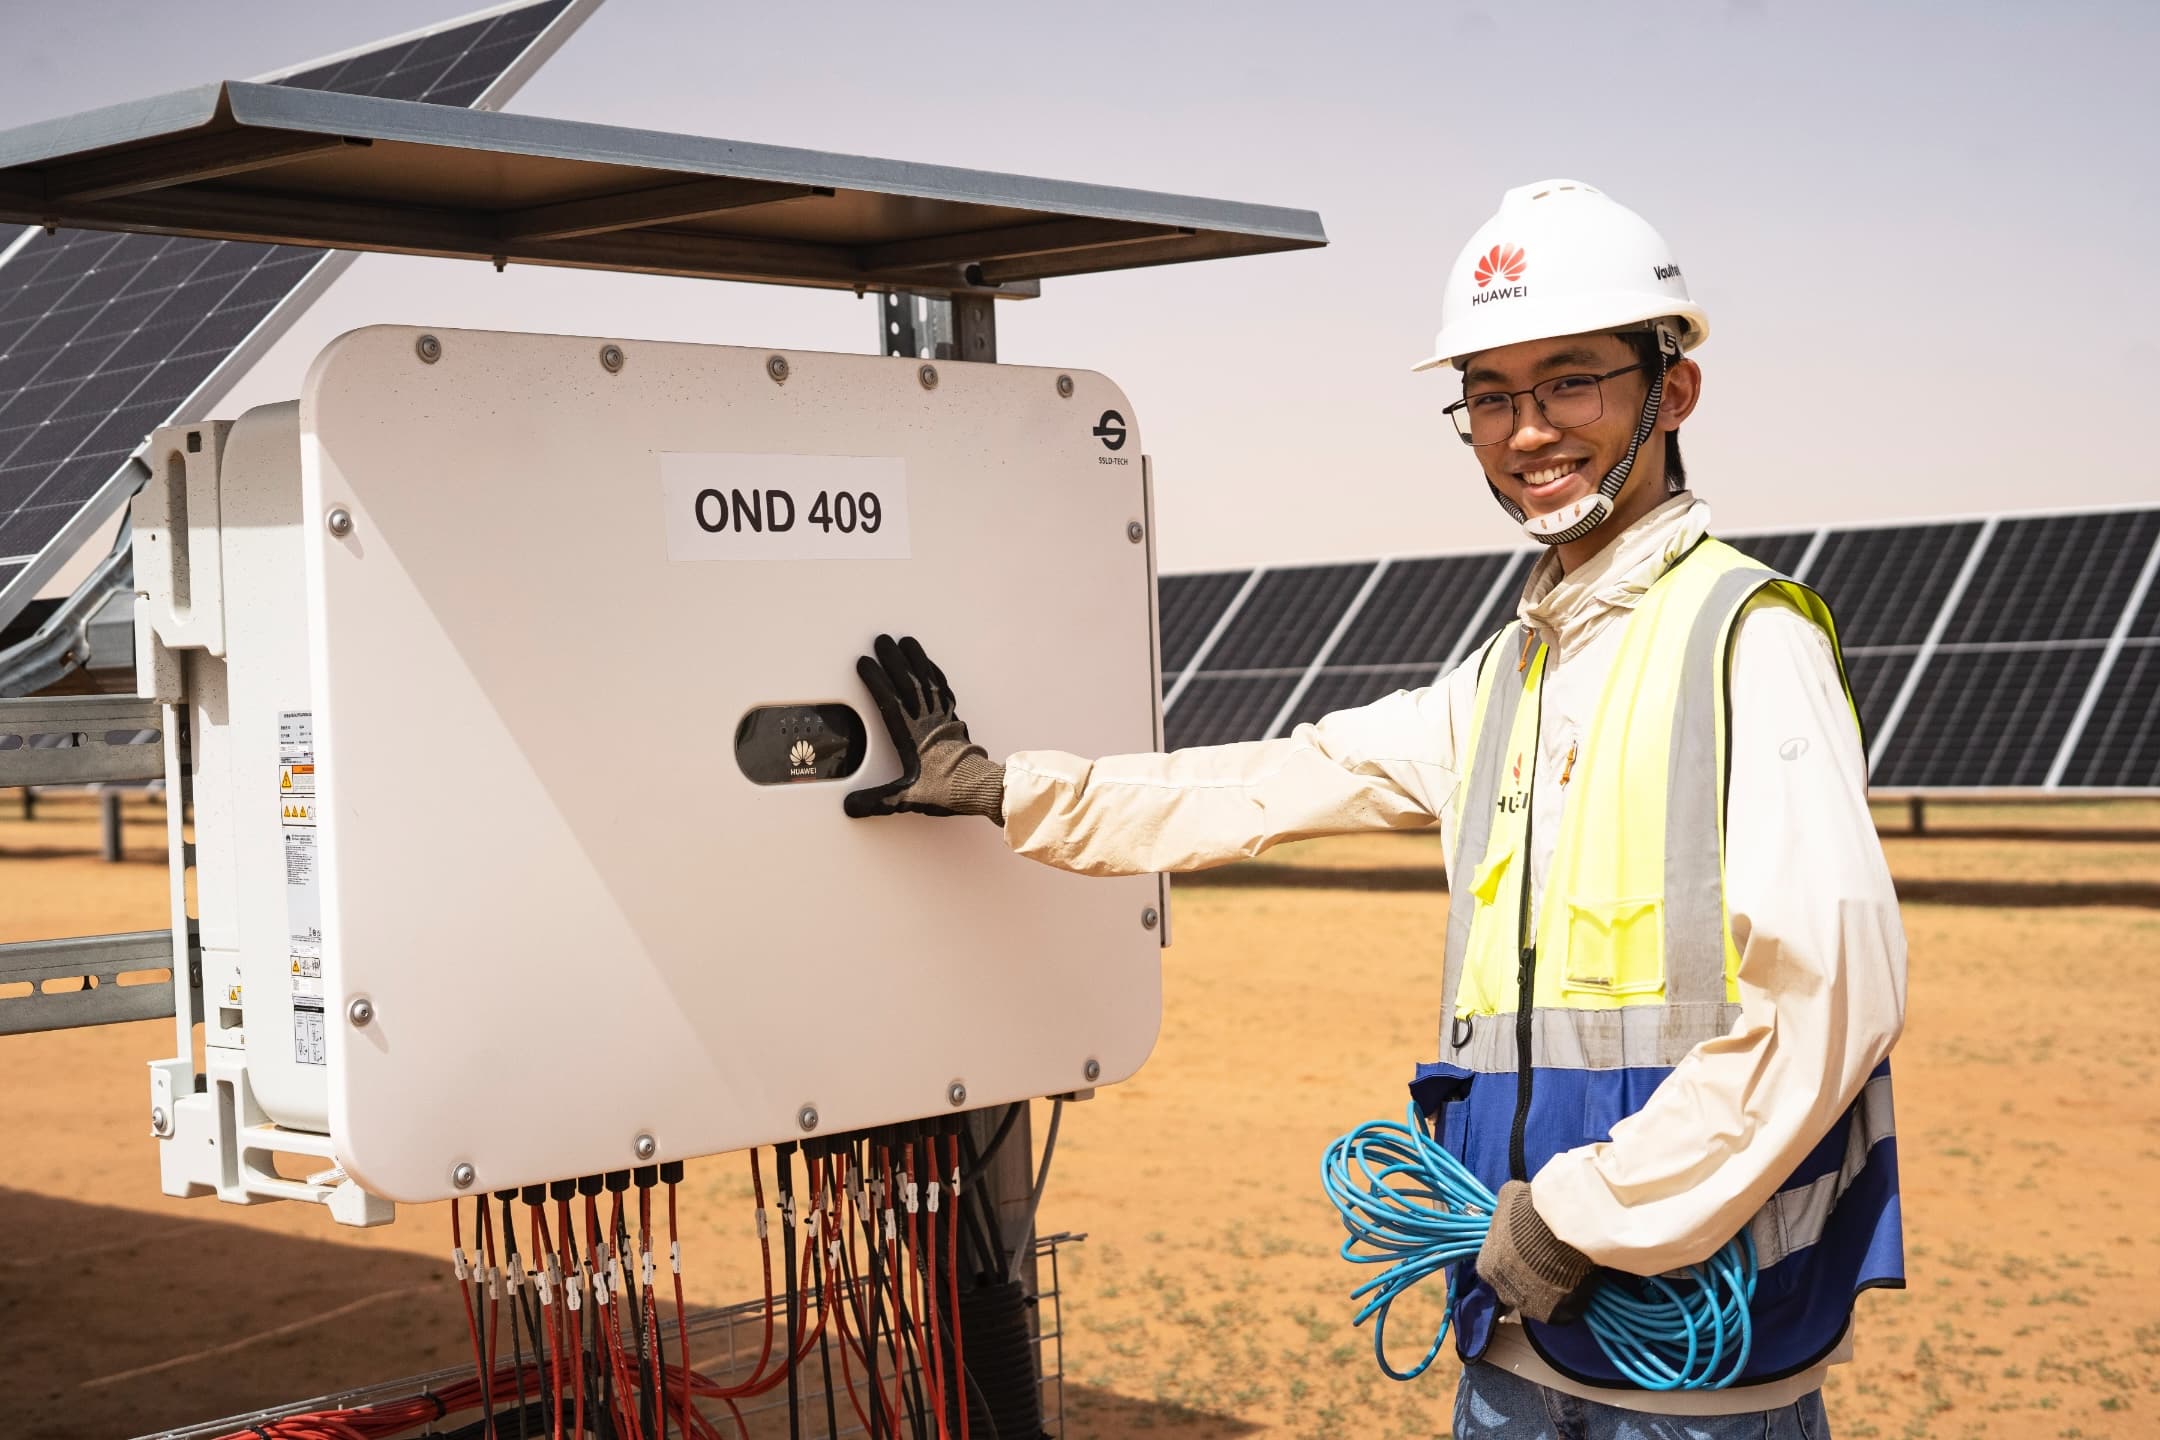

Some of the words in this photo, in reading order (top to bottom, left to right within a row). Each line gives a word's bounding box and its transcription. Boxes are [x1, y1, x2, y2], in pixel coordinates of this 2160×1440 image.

[1472, 286, 1527, 306] HUAWEI
[1098, 456, 1129, 466] SSLD-TECH
[695, 488, 795, 533] OND
[807, 490, 882, 533] 409
[790, 767, 817, 776] HUAWEI
